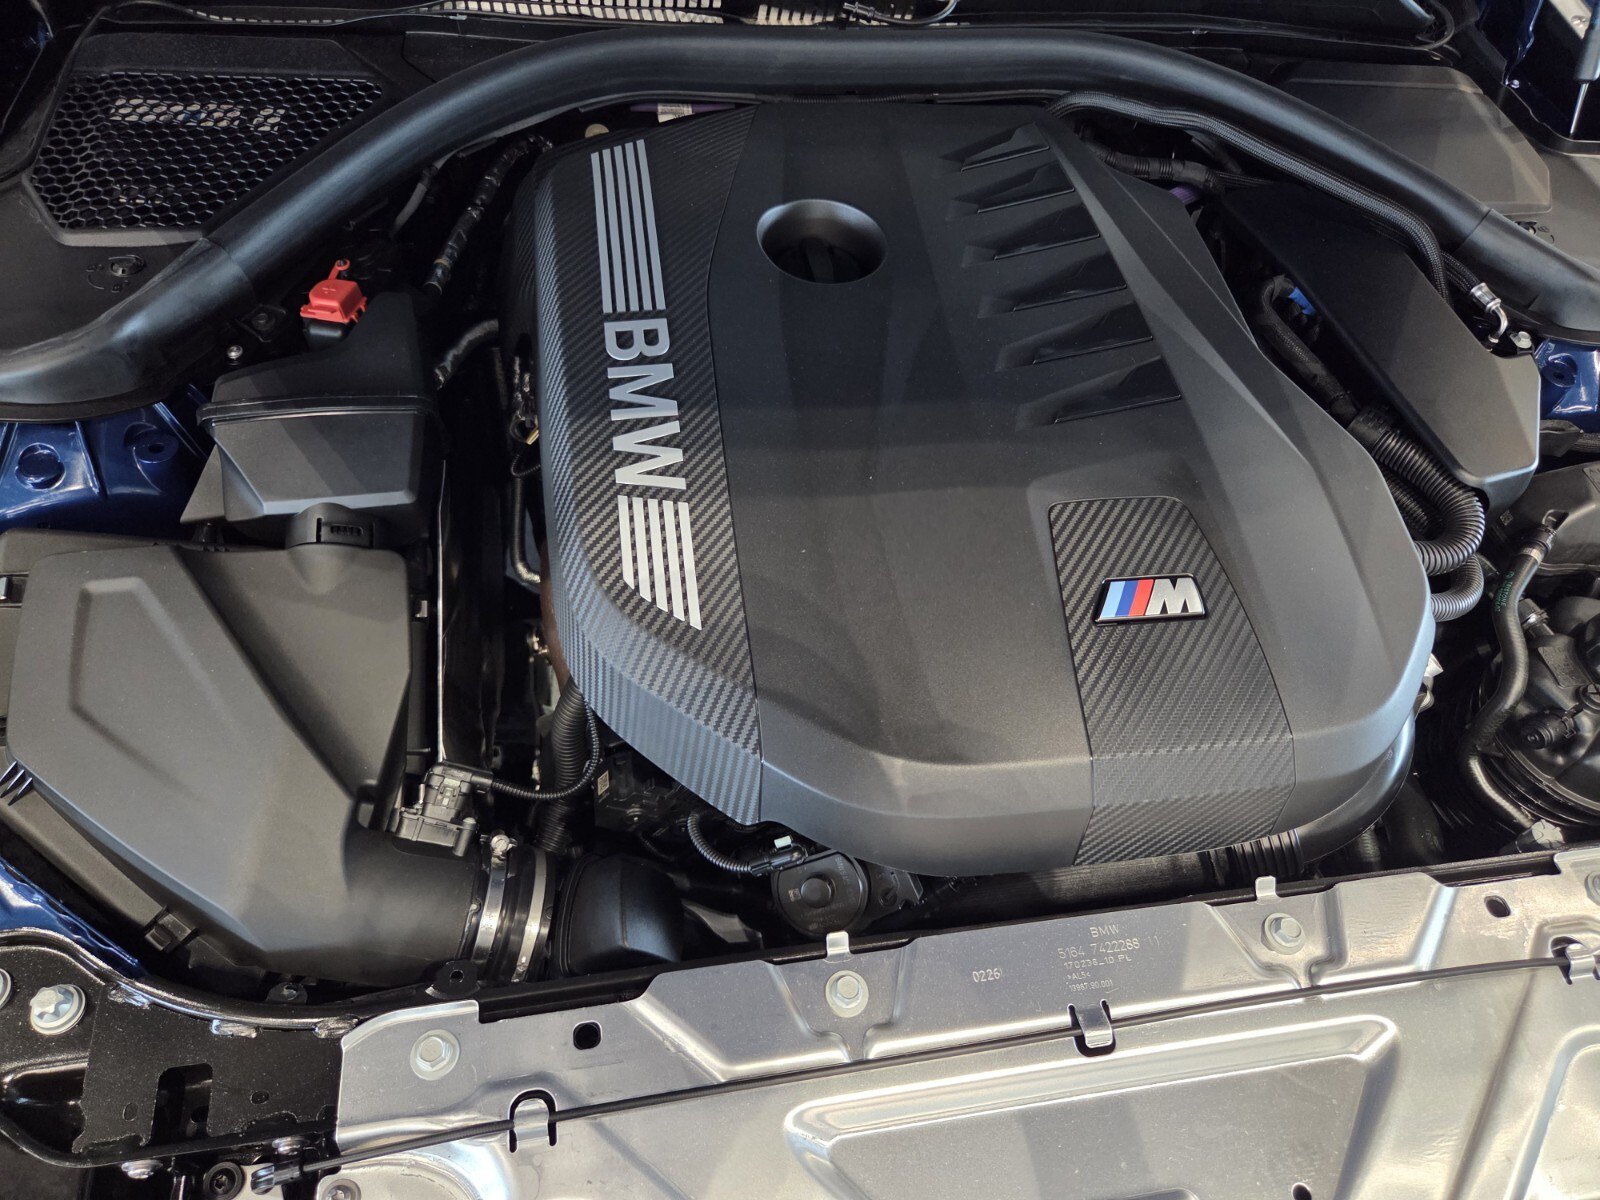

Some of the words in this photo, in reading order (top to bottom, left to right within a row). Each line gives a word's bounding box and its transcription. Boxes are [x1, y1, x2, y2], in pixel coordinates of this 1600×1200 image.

[603, 318, 687, 490] BMW
[1144, 577, 1205, 616] M
[1089, 924, 1120, 938] BMW
[1057, 945, 1085, 959] 5164
